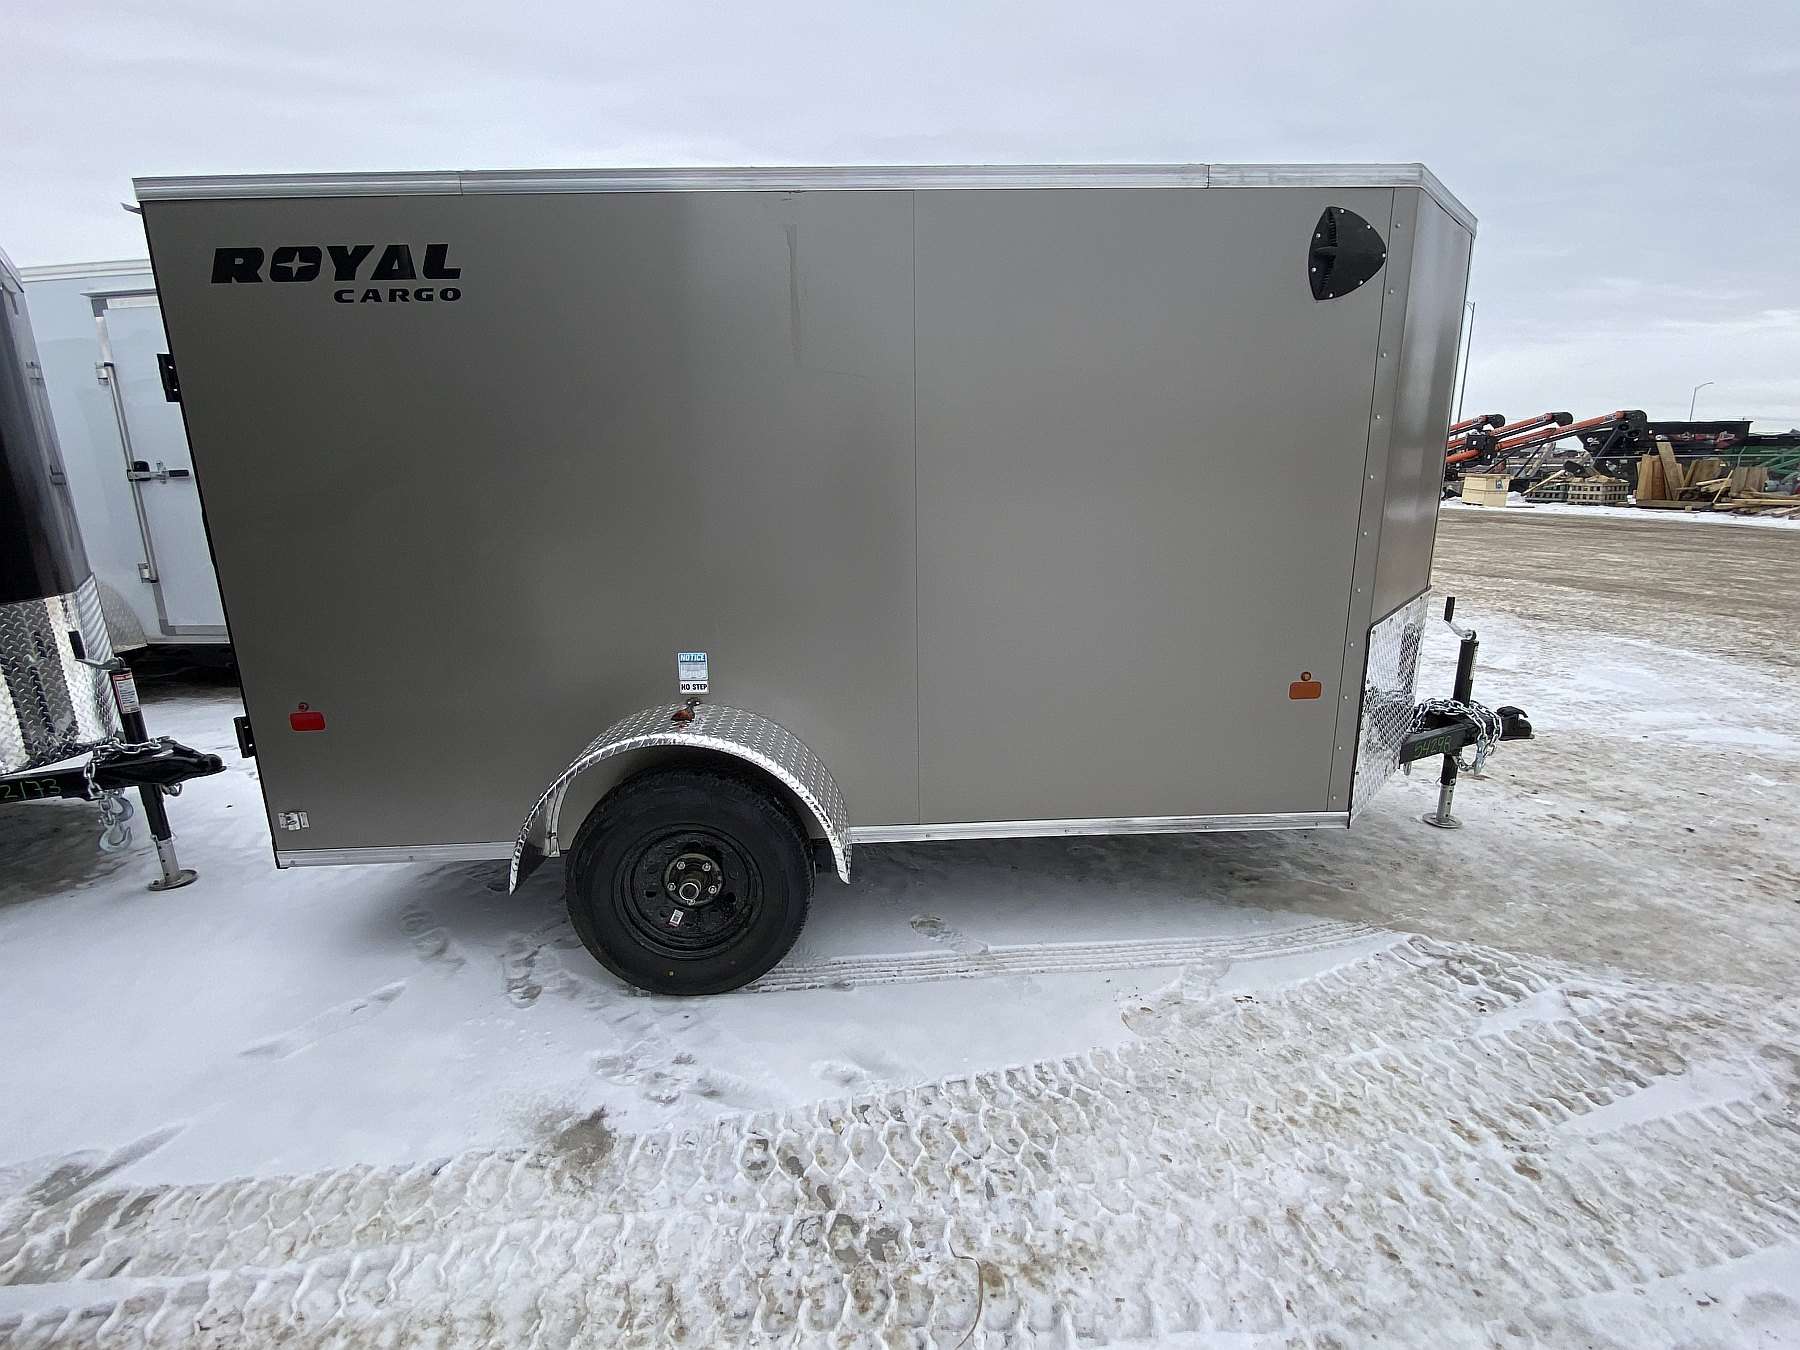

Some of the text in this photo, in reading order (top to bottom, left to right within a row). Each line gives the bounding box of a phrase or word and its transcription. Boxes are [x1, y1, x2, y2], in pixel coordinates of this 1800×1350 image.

[211, 243, 462, 284] ROYAL
[334, 287, 462, 304] CARGO
[680, 654, 705, 662] NOTICE
[681, 683, 708, 691] NO STEP
